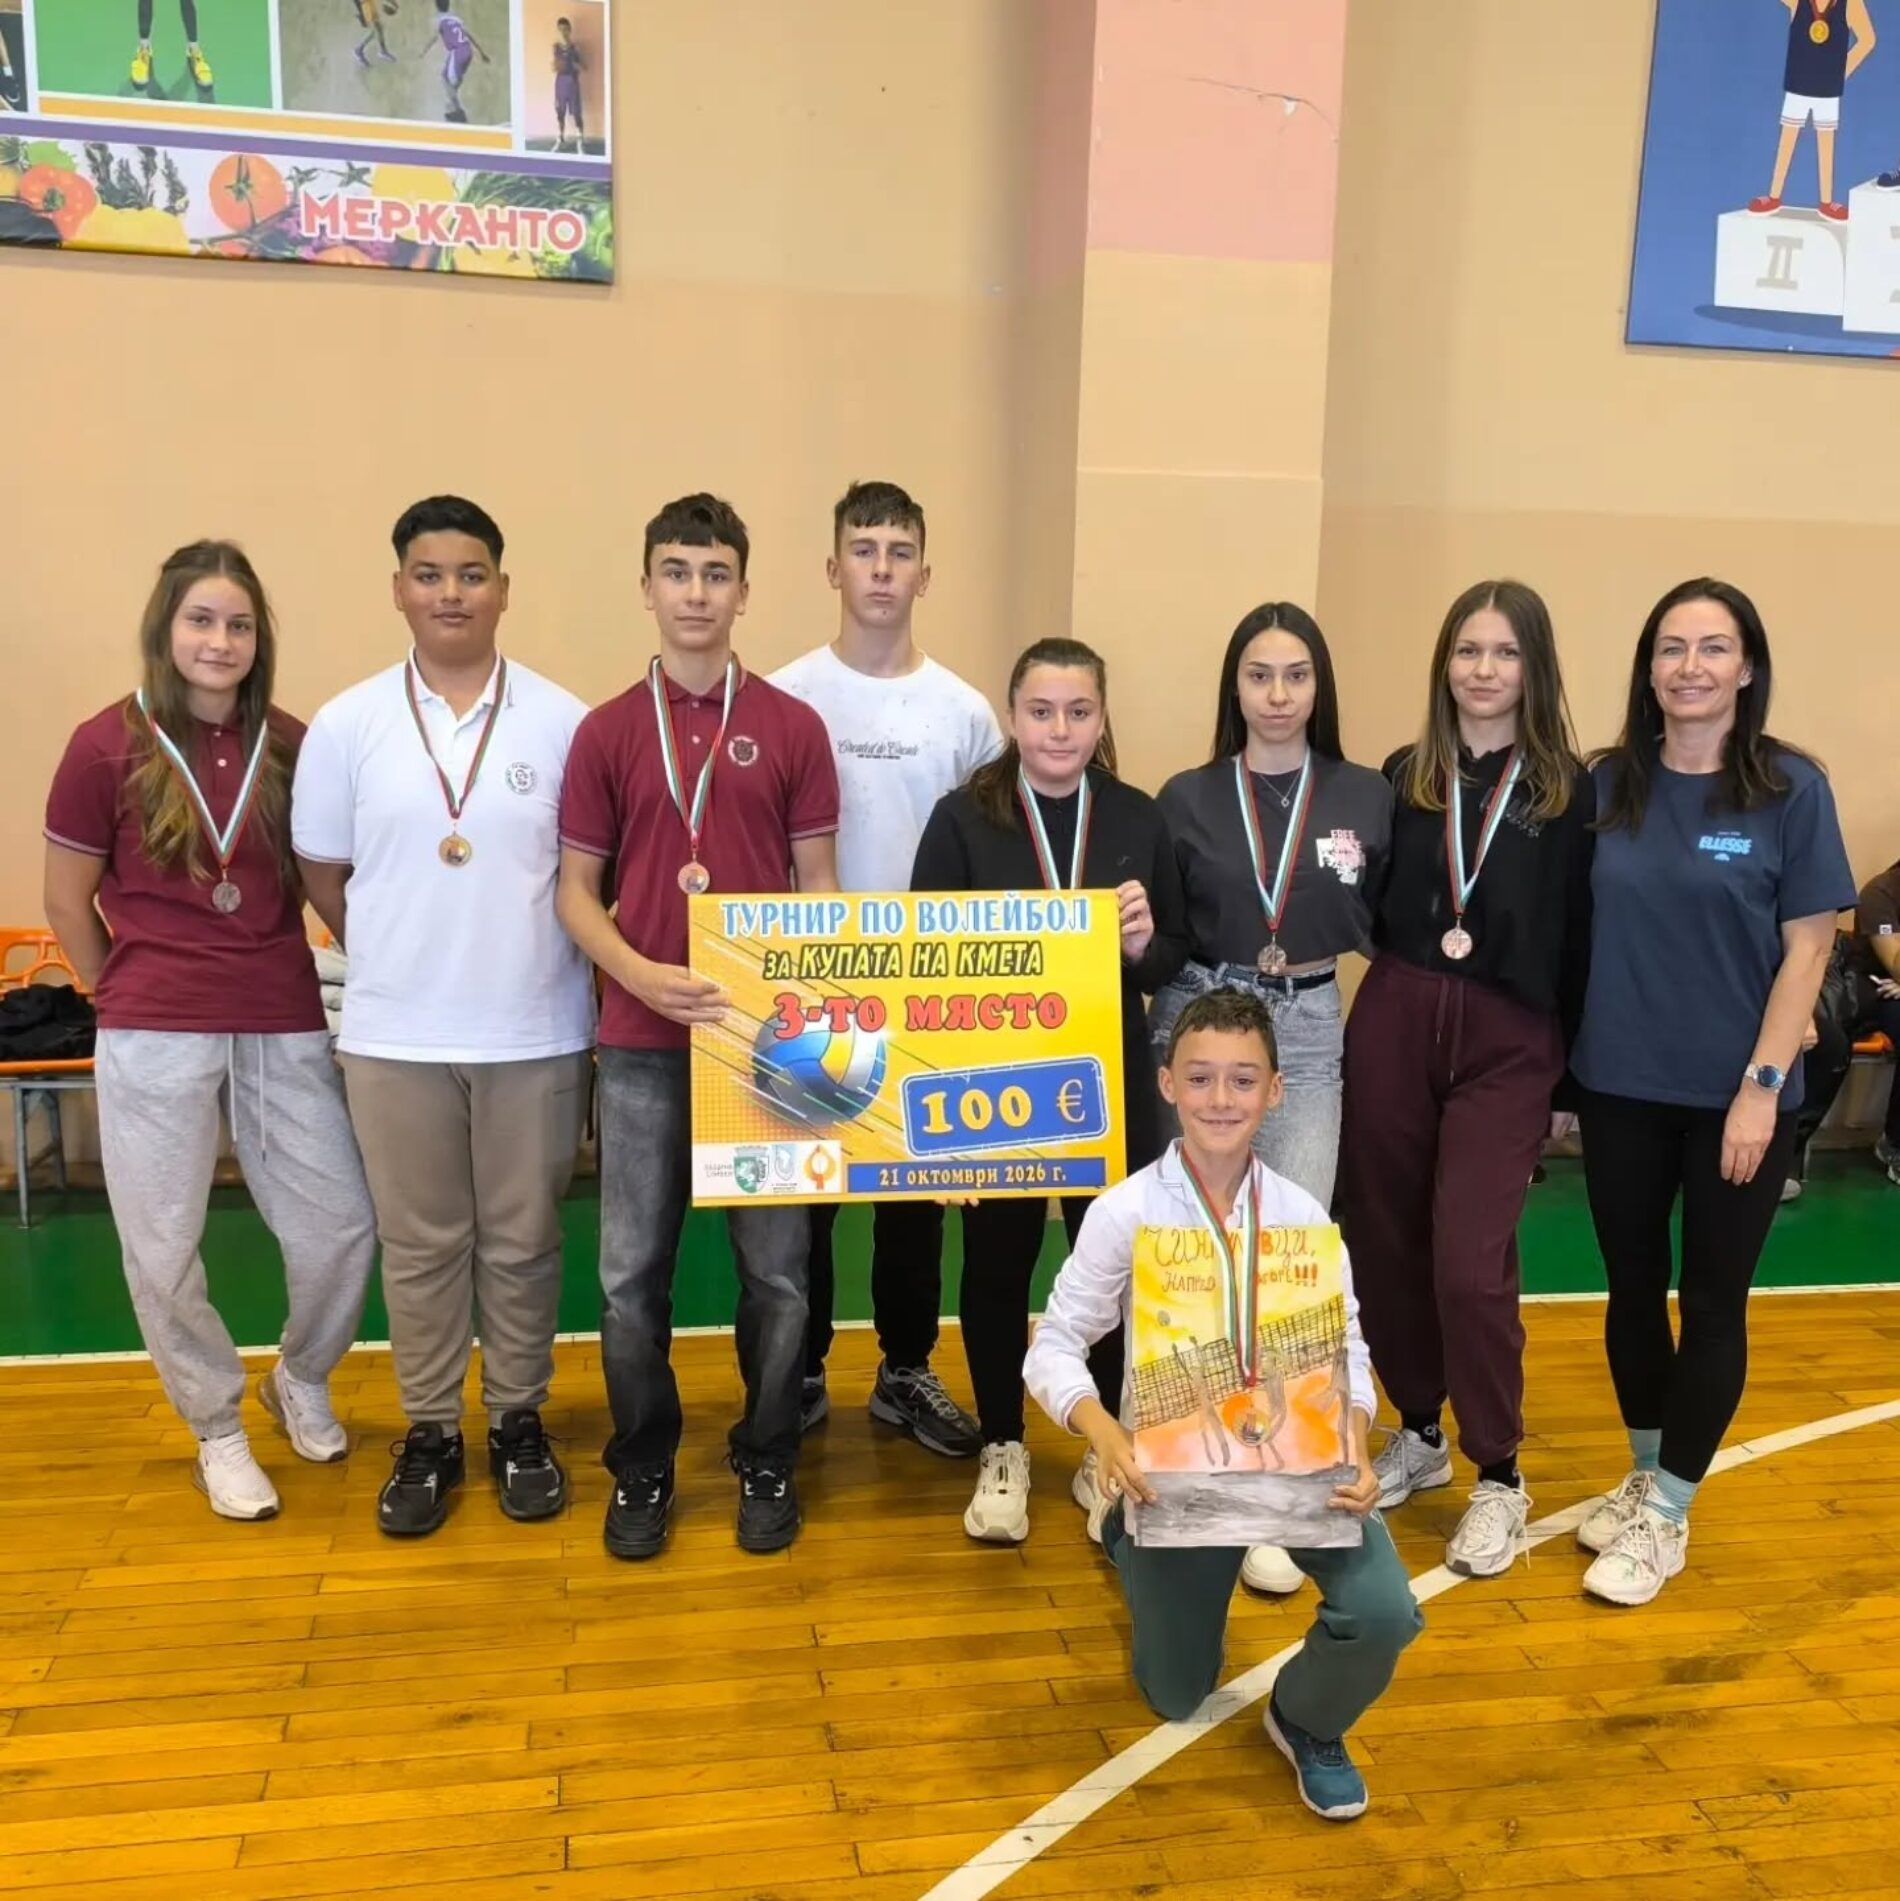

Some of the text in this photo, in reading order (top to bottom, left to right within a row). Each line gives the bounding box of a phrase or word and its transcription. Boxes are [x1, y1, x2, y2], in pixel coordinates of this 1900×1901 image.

[302, 191, 585, 252] МЕРКАНТО
[1699, 836, 1752, 854] ELLESSE
[722, 893, 1090, 937] ТУРНИР ПО ВОЛЕЙБОЛ
[763, 941, 1043, 980] ЗА КУПАТА НА КМЕТА
[773, 992, 1067, 1040] 3-ТО МЯСТО
[921, 1078, 1086, 1134] 100 €
[879, 1163, 1067, 1188] 21 октомври 2026 г.
